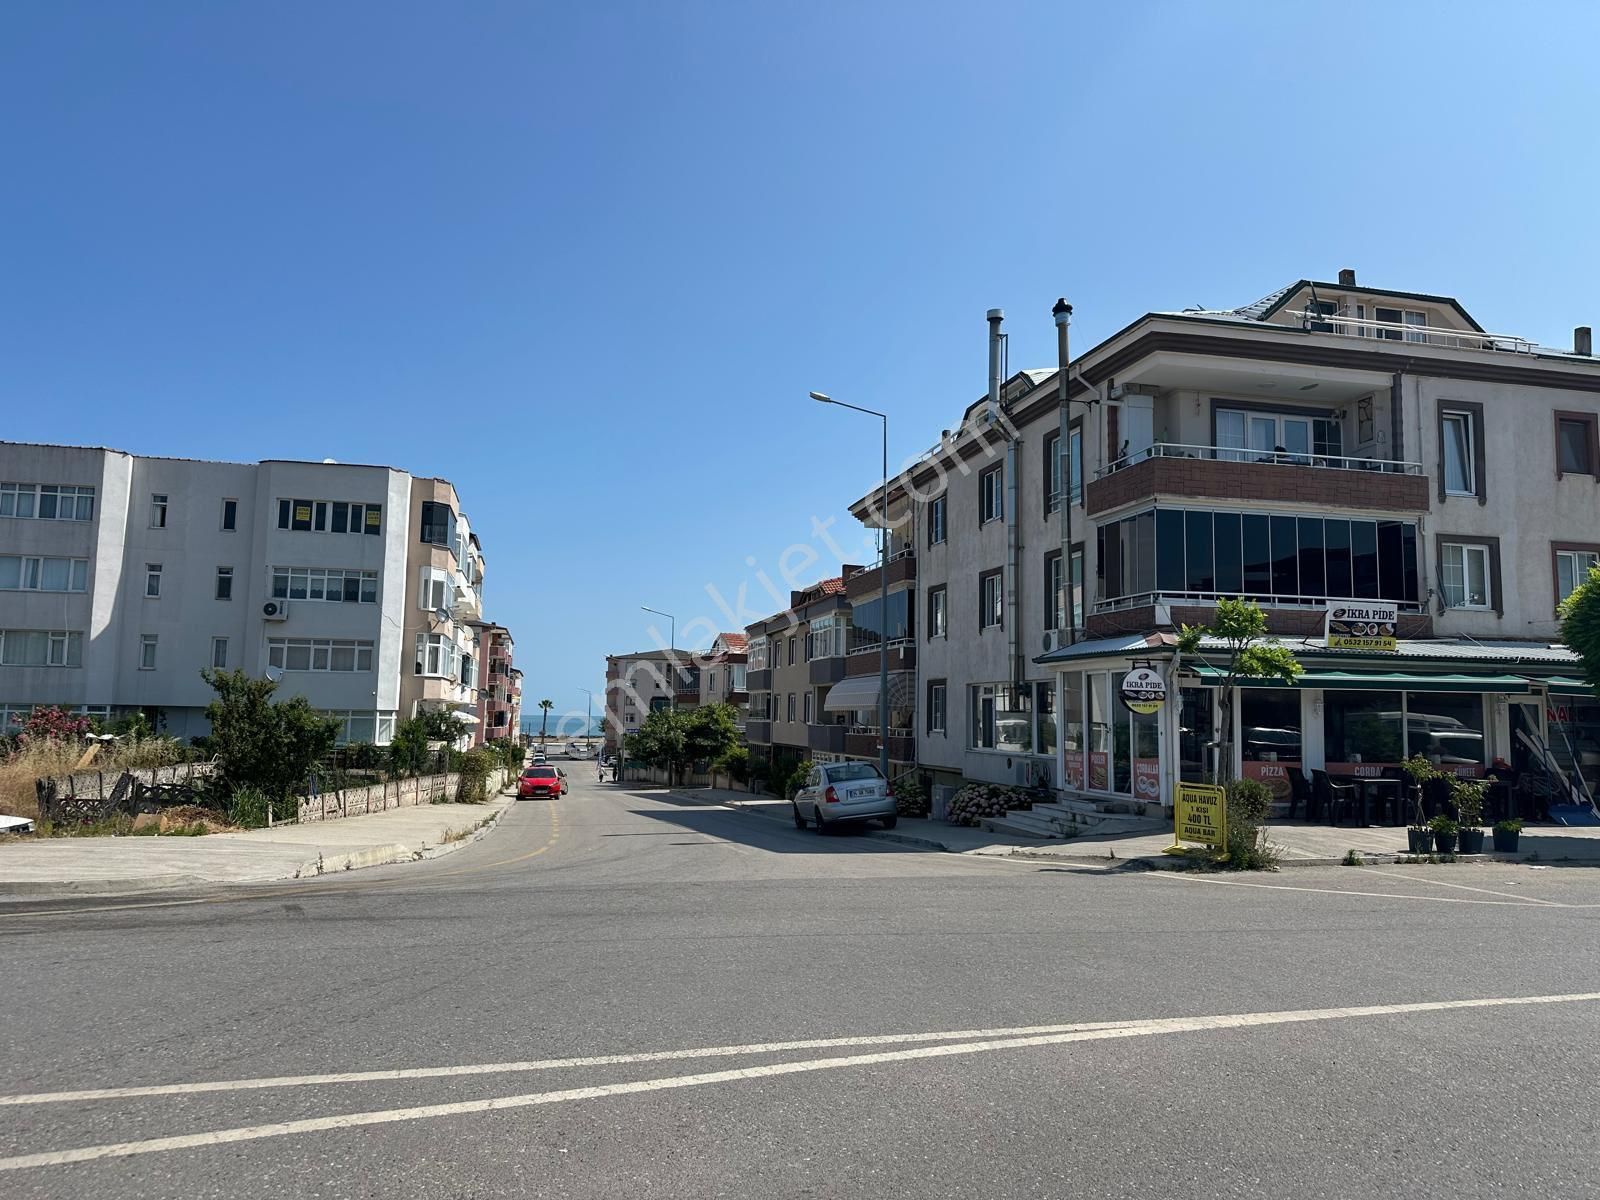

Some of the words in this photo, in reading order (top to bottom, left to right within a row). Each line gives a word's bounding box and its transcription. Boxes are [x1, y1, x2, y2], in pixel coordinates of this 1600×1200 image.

[1182, 794, 1197, 804] AQUA
[1188, 813, 1202, 824] 400
[1204, 815, 1212, 825] TL
[1184, 827, 1201, 835] AQUA
